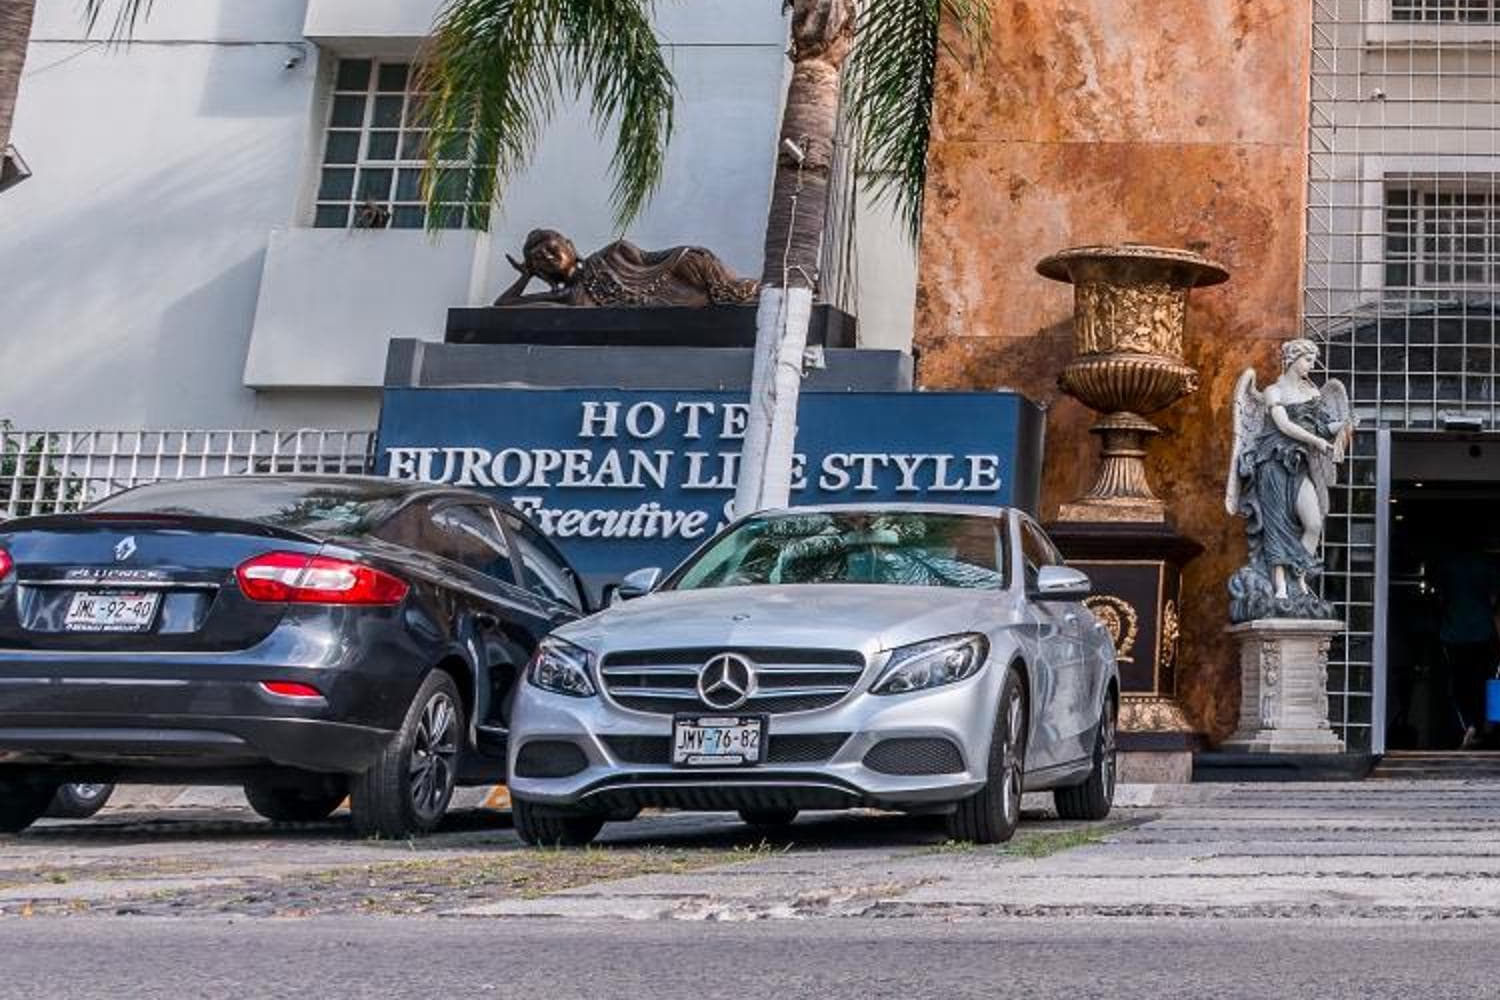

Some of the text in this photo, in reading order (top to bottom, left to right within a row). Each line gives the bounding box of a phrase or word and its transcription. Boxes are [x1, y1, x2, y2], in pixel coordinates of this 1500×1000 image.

[579, 401, 799, 438] HOTE
[386, 446, 1001, 492] EUROPEAN LIE STYLE
[678, 730, 759, 749] JMV-76-82
